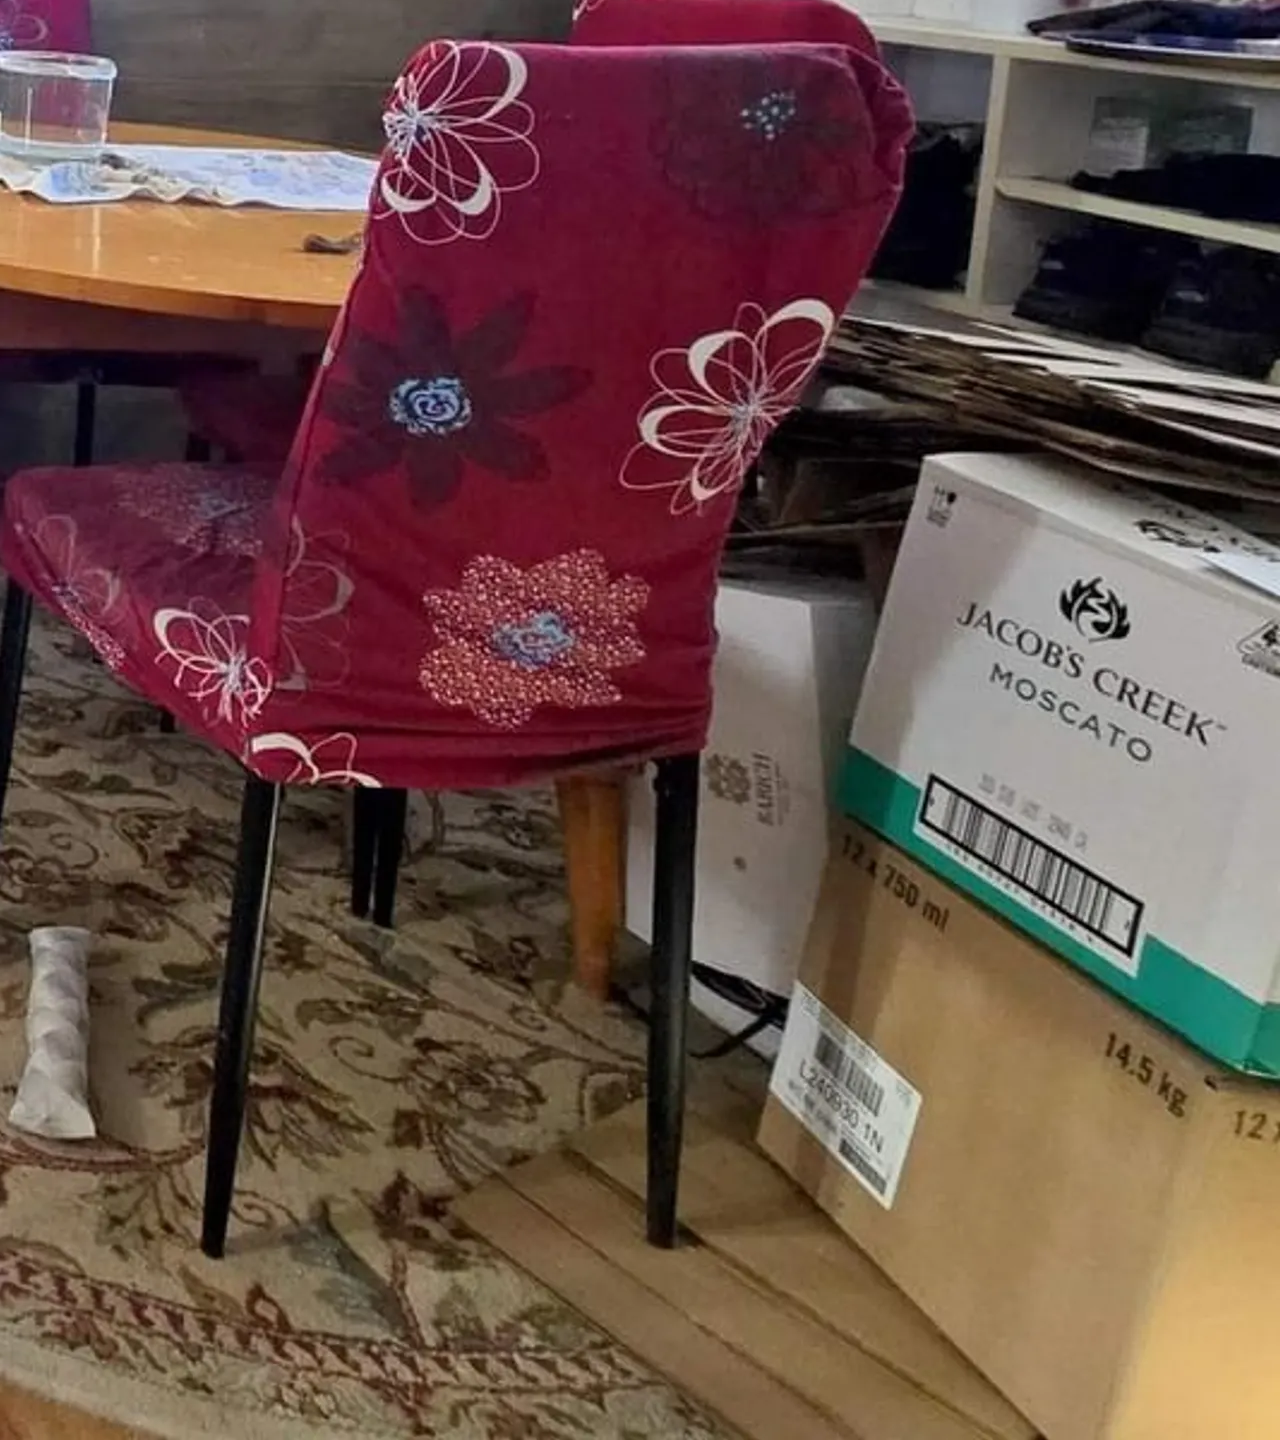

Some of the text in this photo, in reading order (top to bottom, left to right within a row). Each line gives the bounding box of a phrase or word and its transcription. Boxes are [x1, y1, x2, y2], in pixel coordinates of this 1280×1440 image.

[956, 602, 1085, 679] JACOB'S
[989, 662, 1153, 762] MOSCATO
[841, 833, 864, 863] 12
[882, 863, 920, 910] 750
[922, 898, 951, 934] ml
[1105, 1032, 1189, 1119] 14.5 kg
[1234, 1110, 1268, 1140] 12
